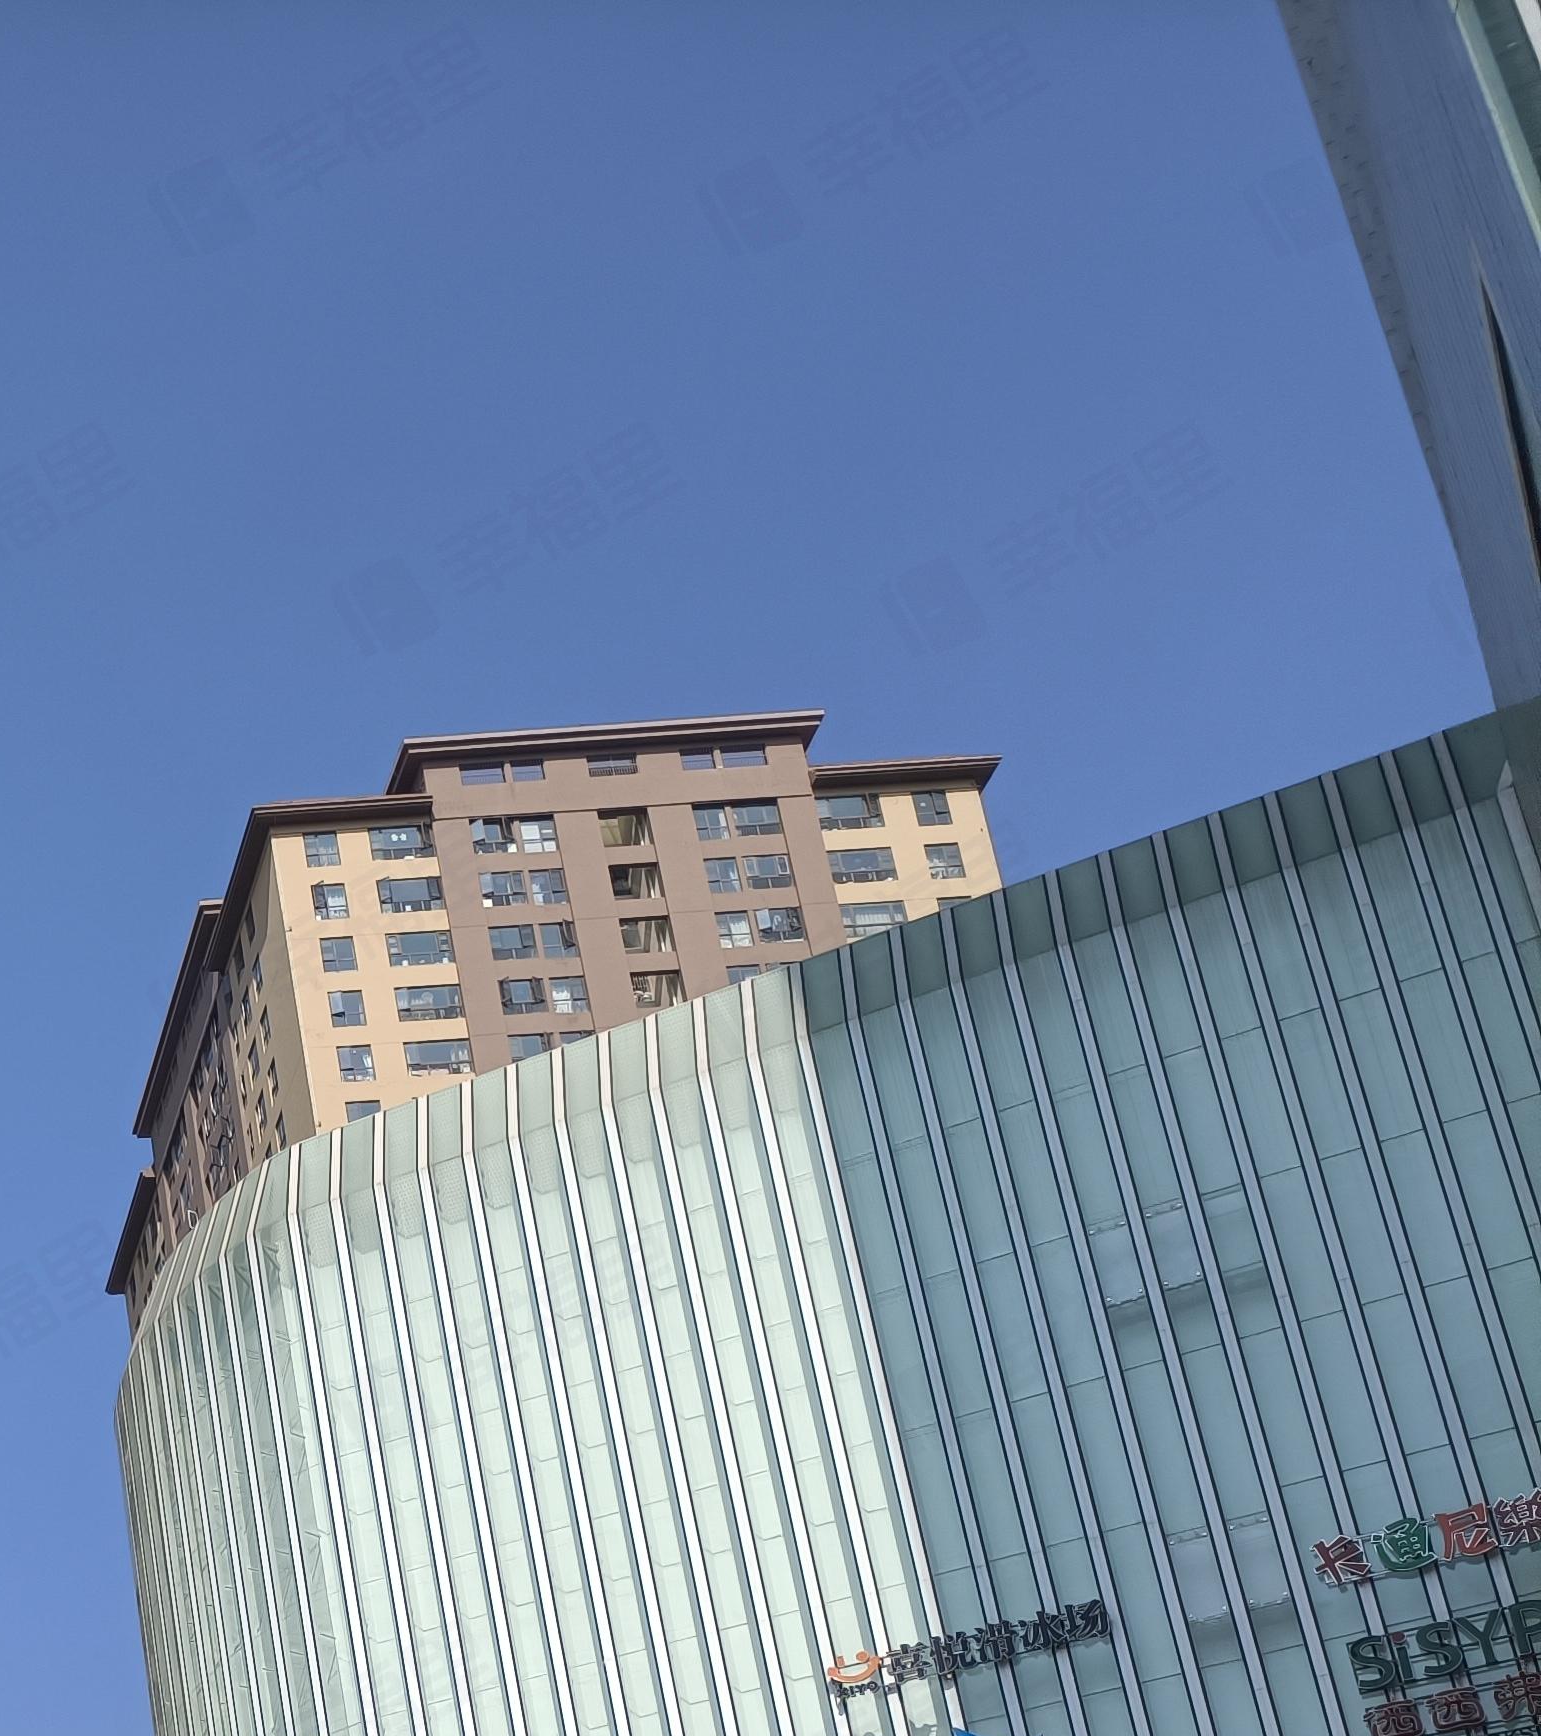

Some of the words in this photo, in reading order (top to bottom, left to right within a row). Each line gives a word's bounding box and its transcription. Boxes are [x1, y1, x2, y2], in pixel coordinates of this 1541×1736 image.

[885, 1599, 1110, 1684] 喜悦滑冰场
